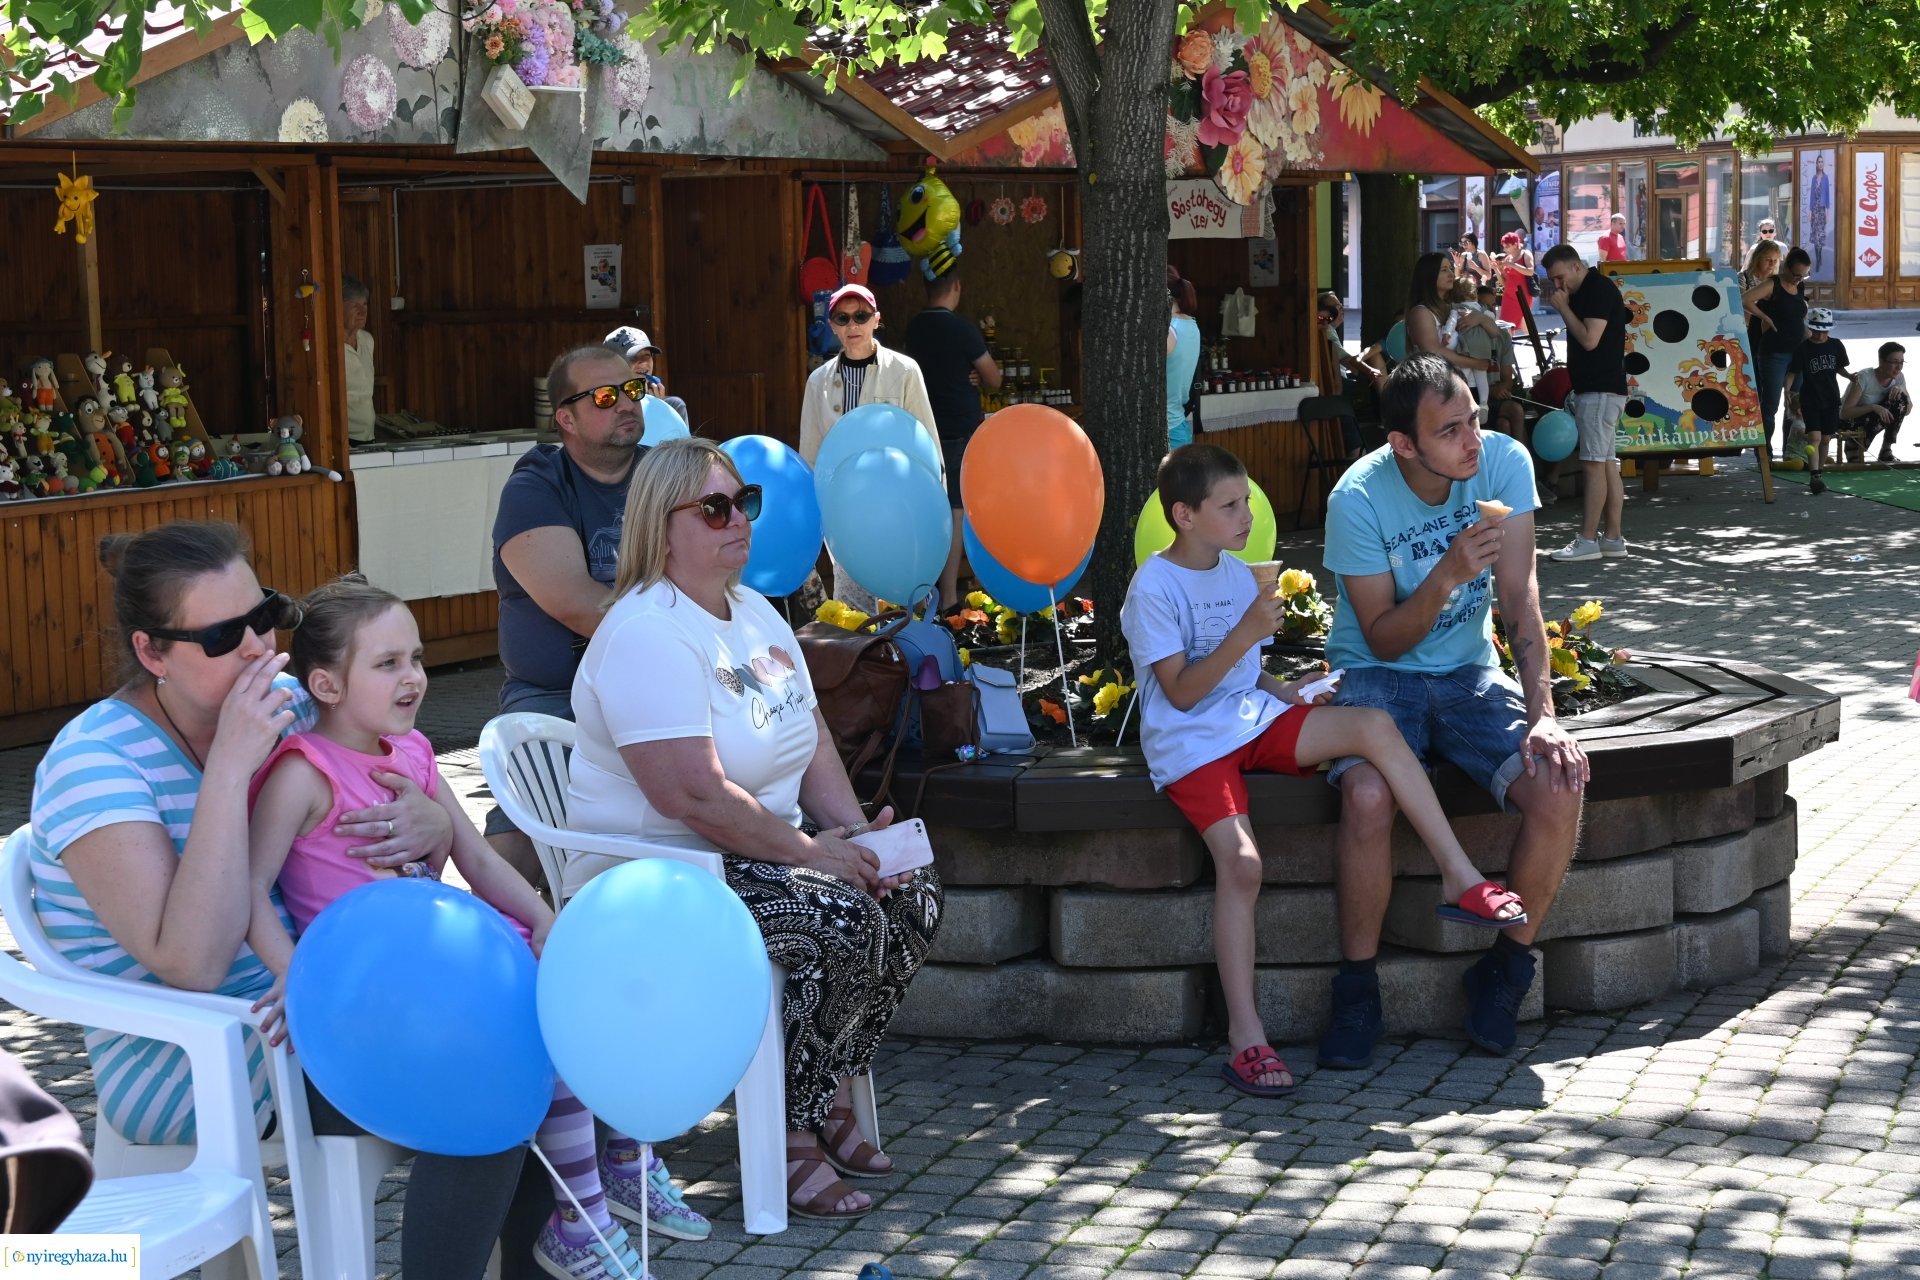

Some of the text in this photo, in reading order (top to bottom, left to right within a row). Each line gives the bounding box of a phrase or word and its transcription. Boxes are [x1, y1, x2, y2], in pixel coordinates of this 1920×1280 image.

[1859, 163, 1882, 212] Cooper
[1858, 215, 1878, 236] Lee
[1615, 420, 1760, 448] Sárkányetető
[1385, 501, 1480, 553] SEAPLANE SQU
